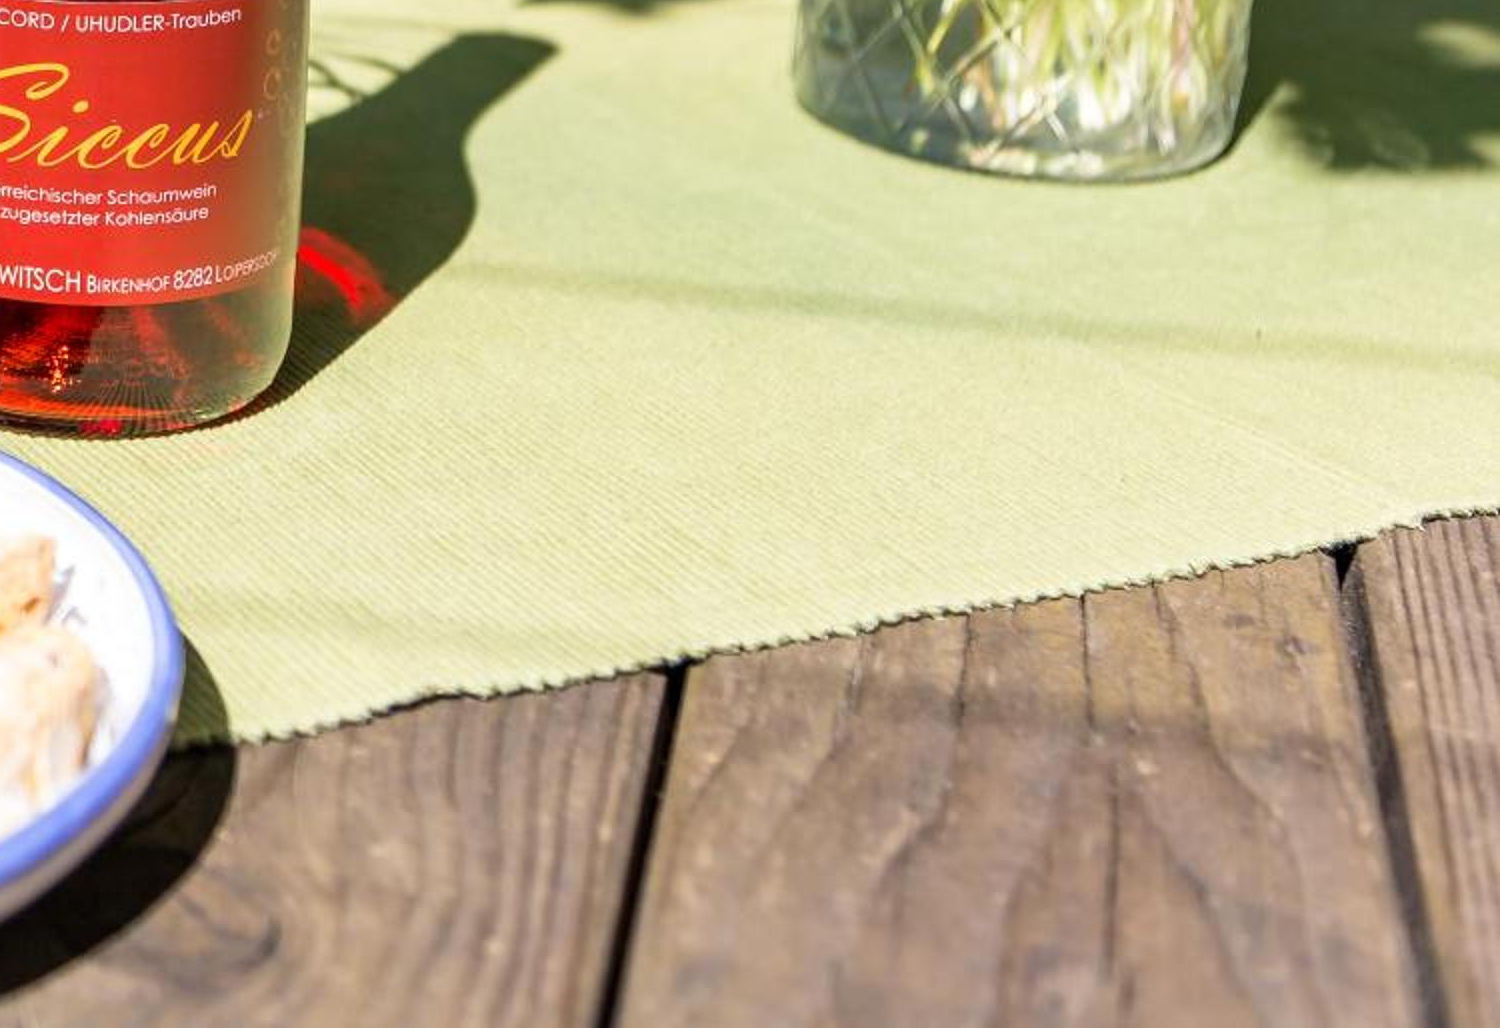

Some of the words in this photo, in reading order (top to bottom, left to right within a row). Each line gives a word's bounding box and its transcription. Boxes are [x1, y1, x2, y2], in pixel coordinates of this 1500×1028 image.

[60, 14, 71, 33] /
[75, 8, 242, 33] UHUDLER-Trauben
[107, 182, 217, 205] Schaumwein
[0, 205, 100, 226] zugesetzter
[105, 206, 209, 226] Kohlensäure
[86, 274, 170, 294] BIRKENHOF
[173, 265, 213, 290] 8282
